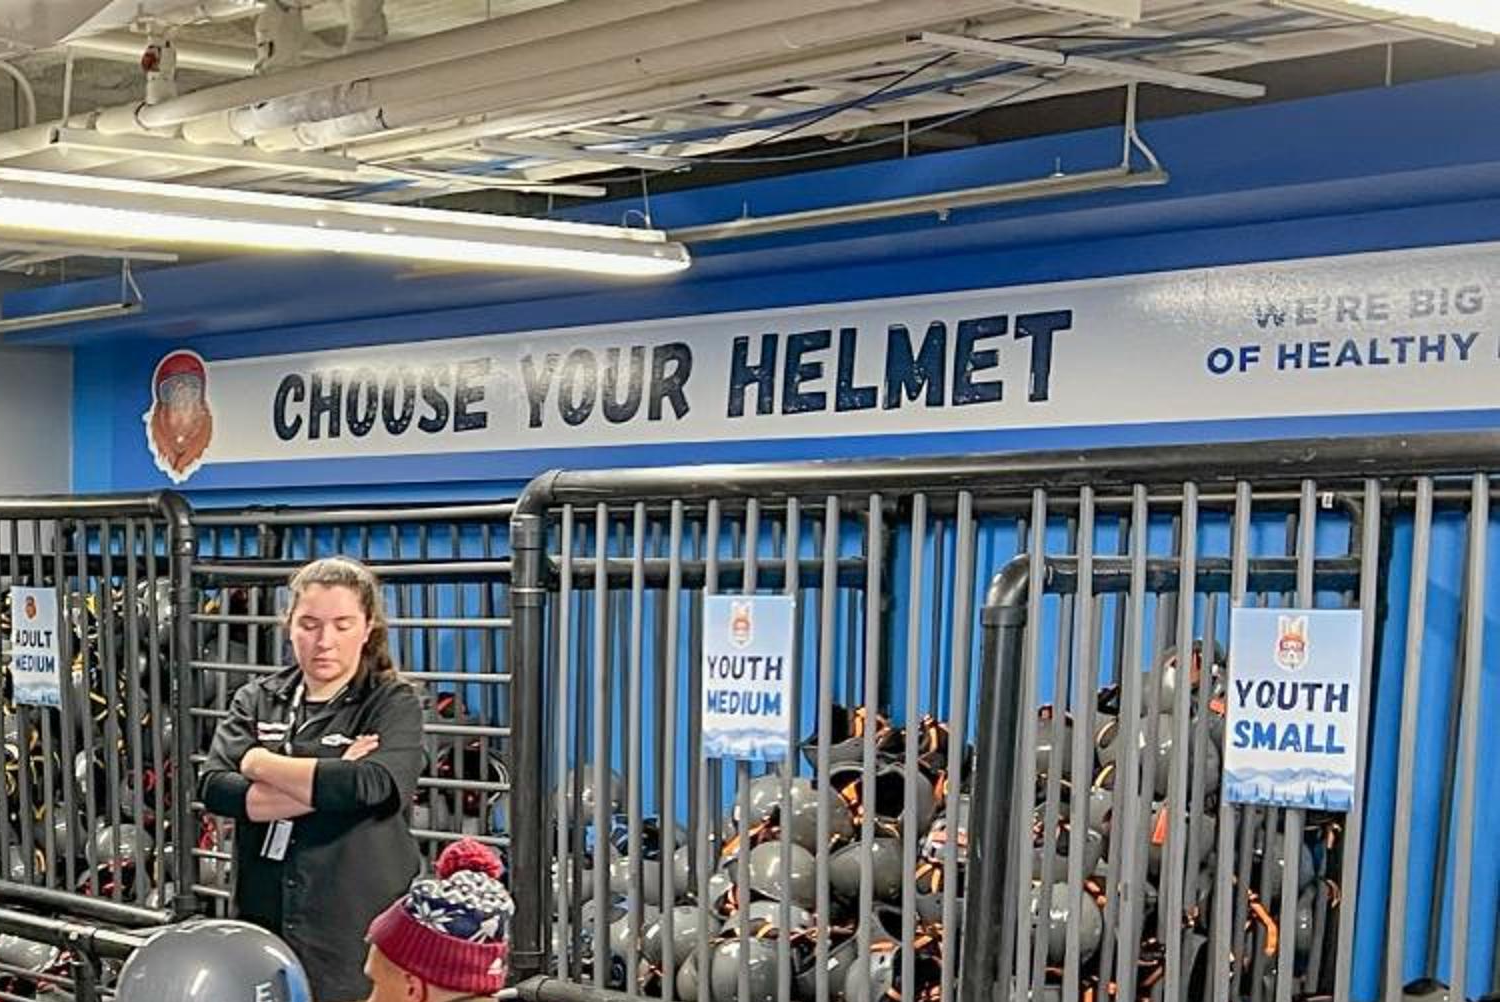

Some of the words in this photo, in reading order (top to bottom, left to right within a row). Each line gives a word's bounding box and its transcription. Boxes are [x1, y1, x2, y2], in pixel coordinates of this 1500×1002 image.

[1409, 286, 1484, 319] BIG
[1206, 345, 1261, 375] OF
[1276, 331, 1479, 370] HEALTHY
[273, 357, 491, 441] CHOOSE
[519, 340, 694, 429] YOUR
[726, 309, 1073, 418] HELMET
[15, 629, 53, 649] ADULT
[15, 654, 55, 674] MEDIUM
[707, 655, 783, 681] YOUTH
[707, 689, 781, 717] MEDIUM
[1235, 678, 1349, 713] YOUTH
[1233, 719, 1345, 754] SMALL
